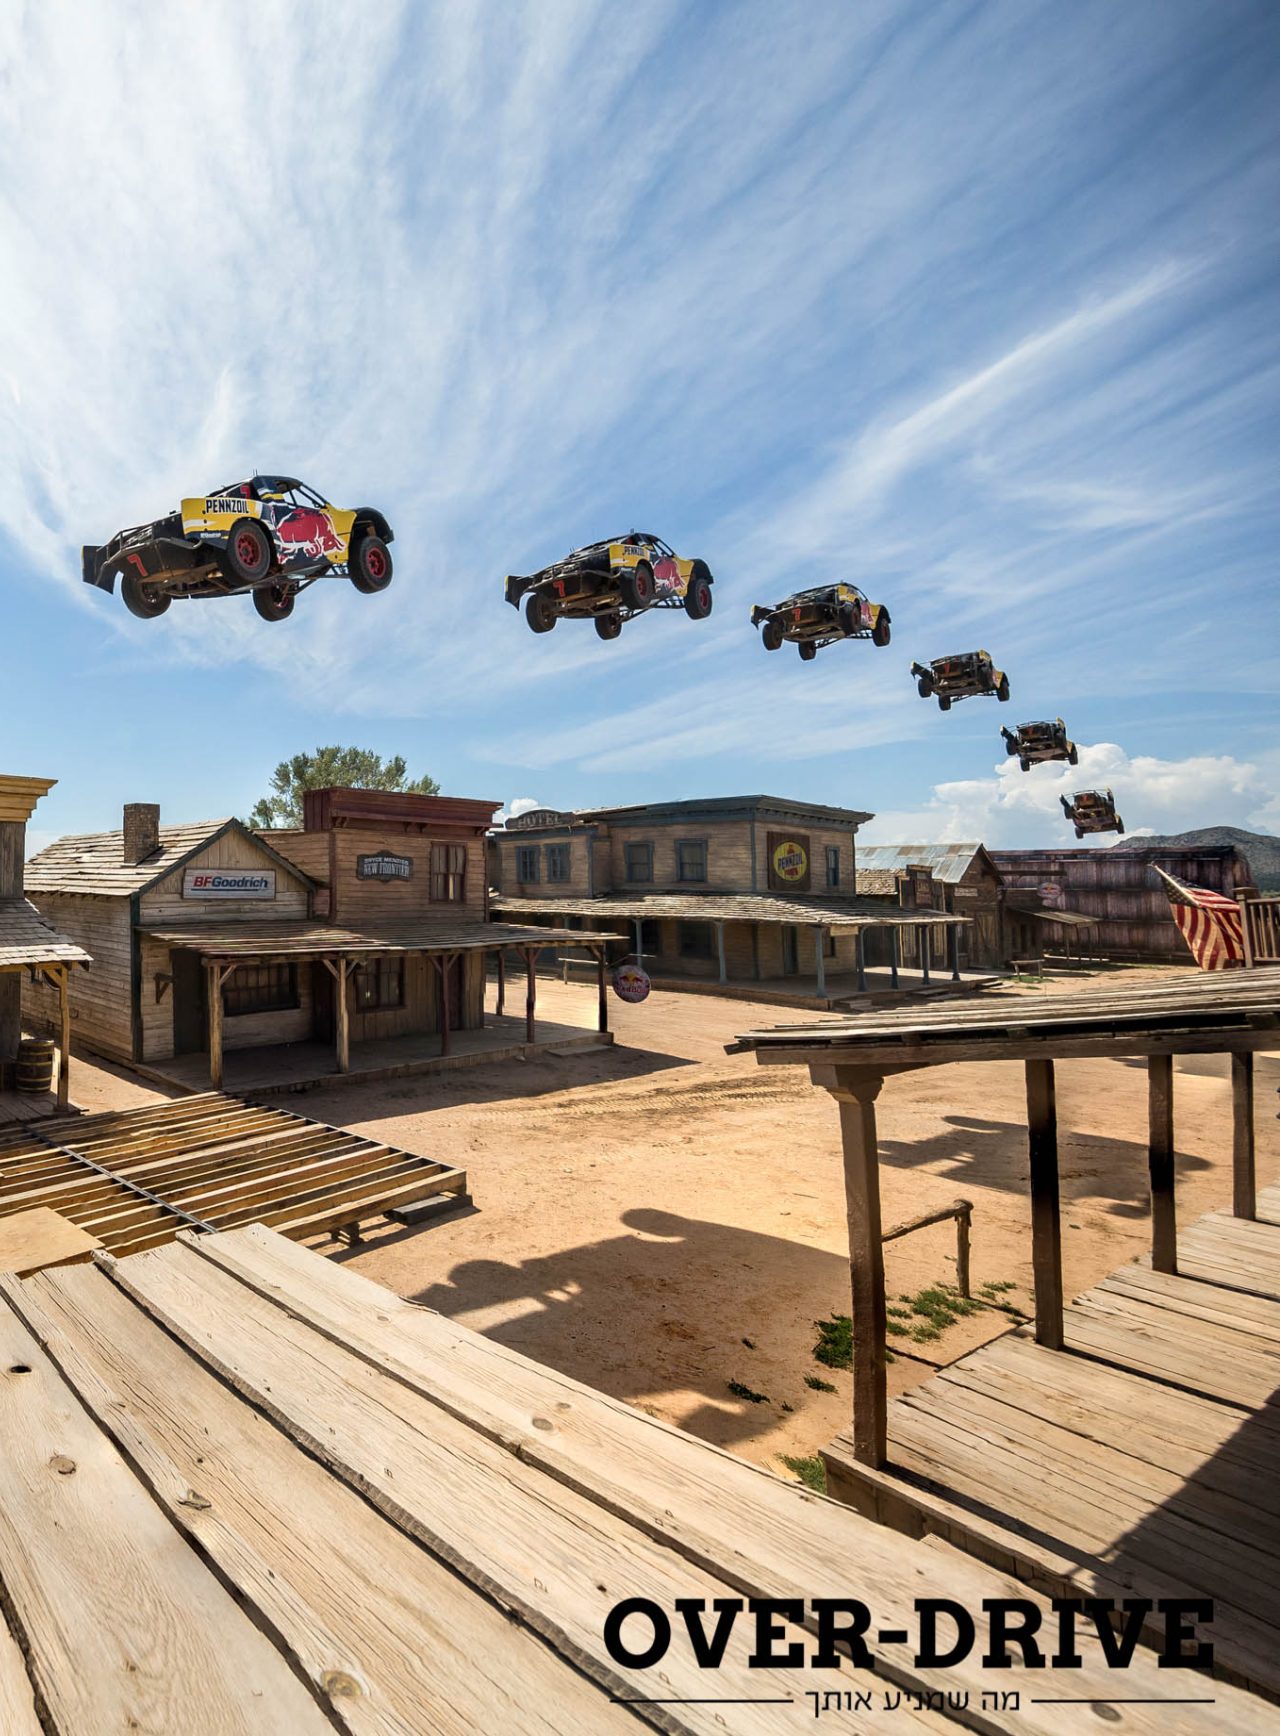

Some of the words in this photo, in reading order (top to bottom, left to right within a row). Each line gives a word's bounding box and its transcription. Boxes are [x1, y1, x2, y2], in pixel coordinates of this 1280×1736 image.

[206, 500, 249, 514] PENNZOIL
[127, 553, 148, 577] 7
[552, 580, 566, 598] 7
[518, 812, 560, 828] HOTEL
[363, 862, 378, 876] NEW
[193, 876, 268, 888] BFGoodrich
